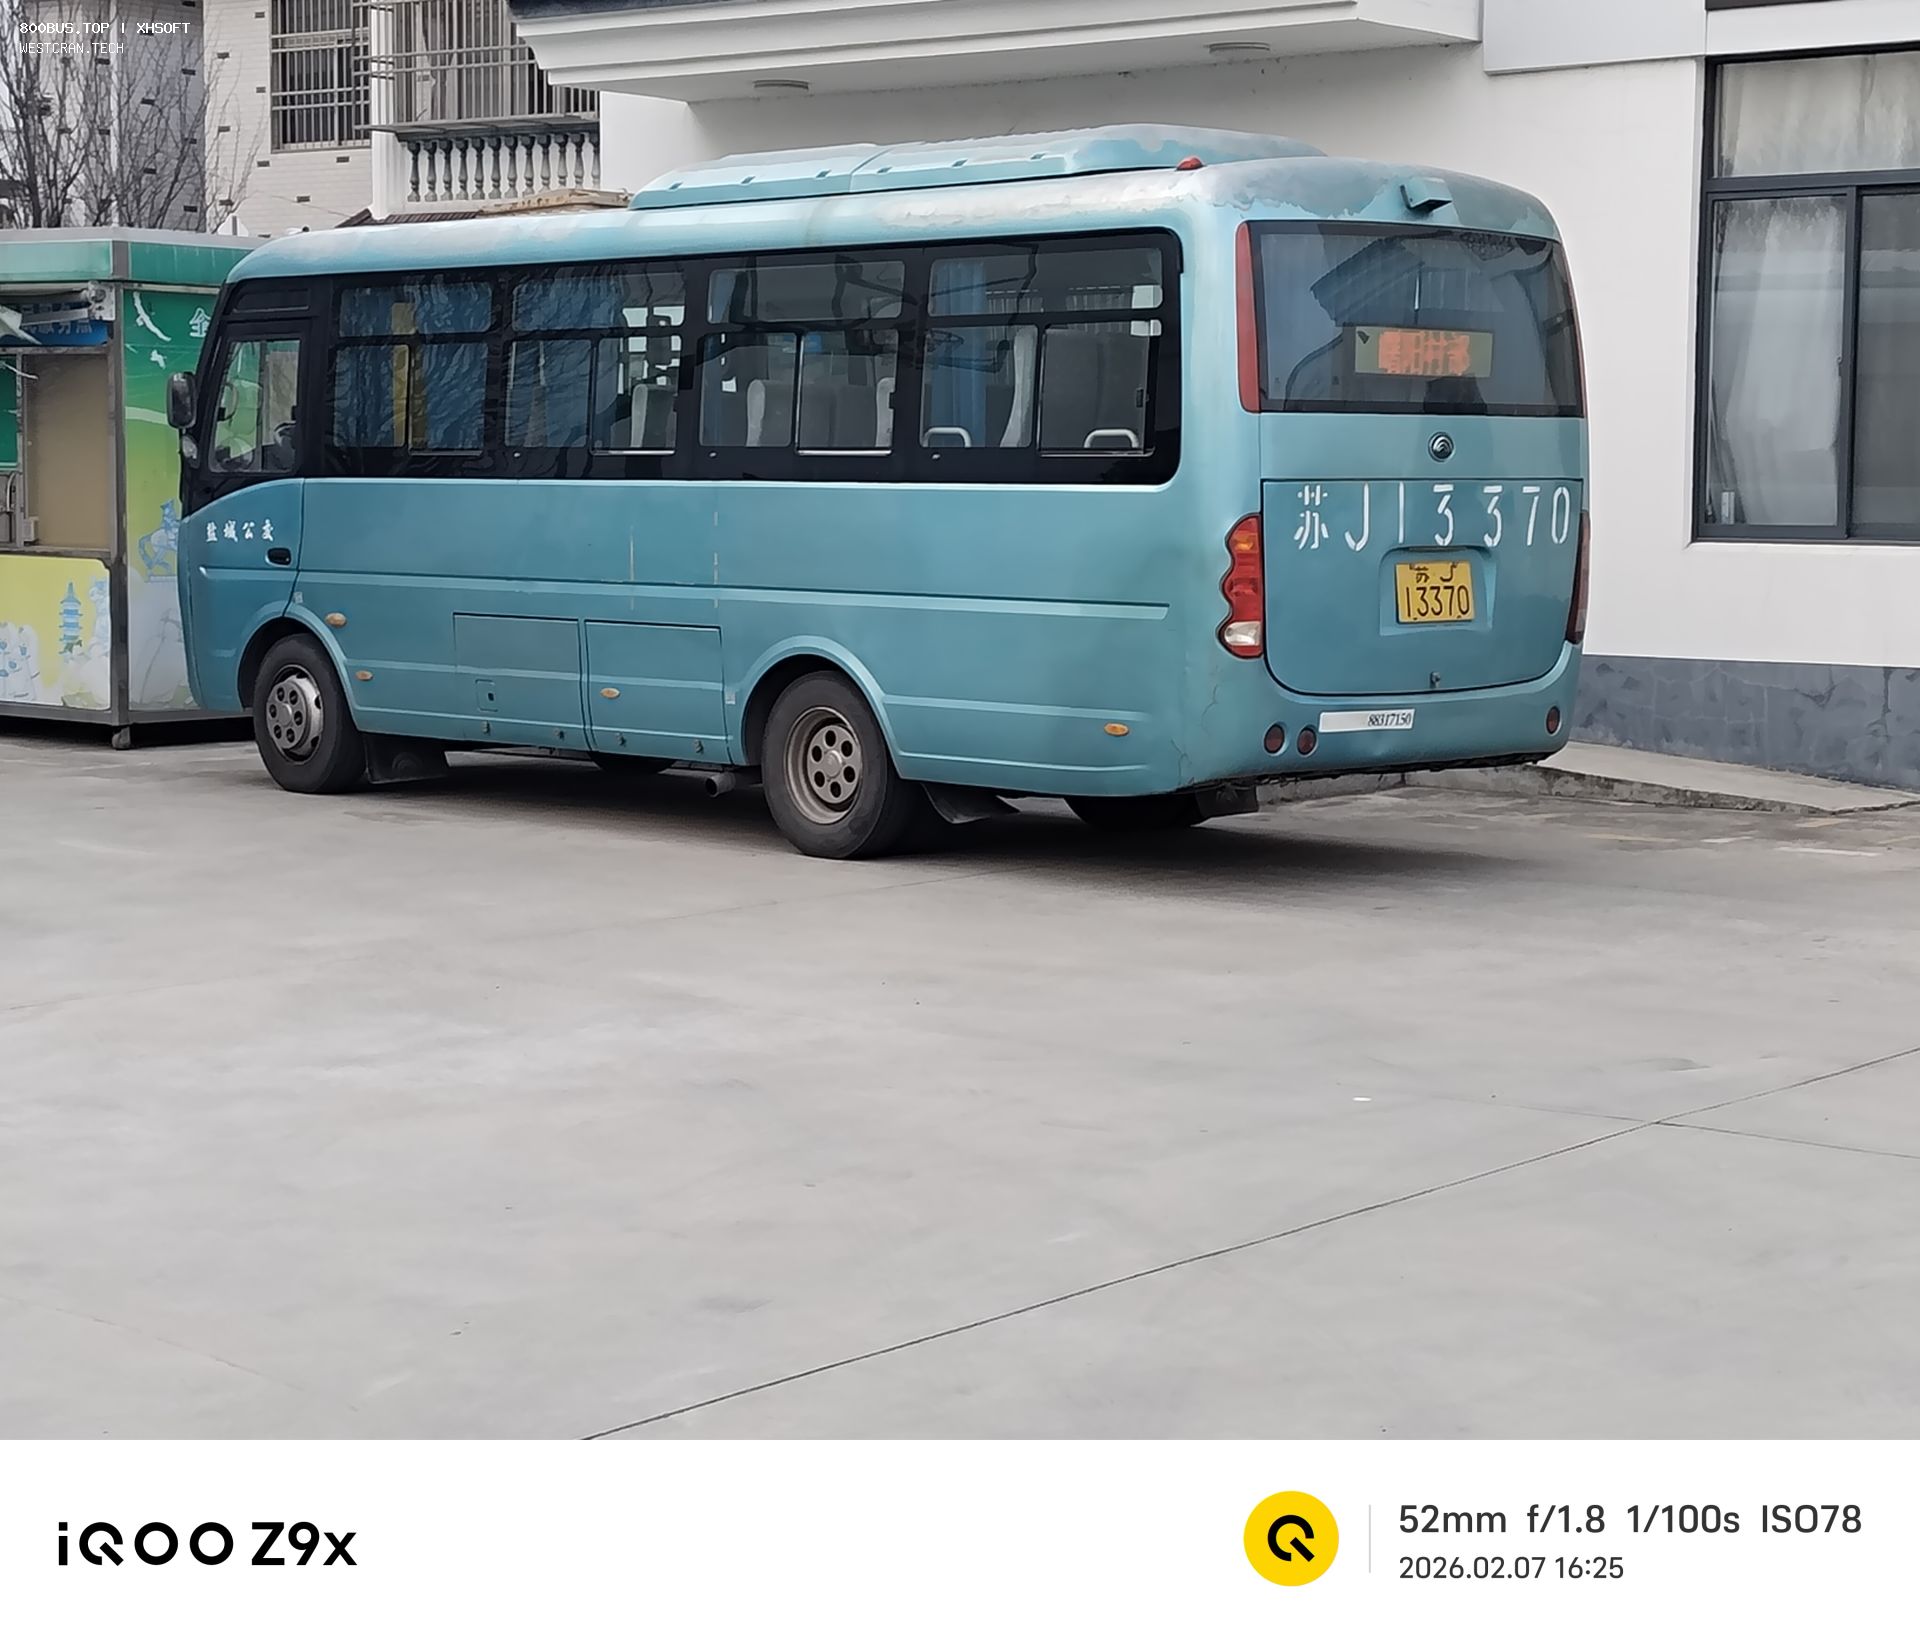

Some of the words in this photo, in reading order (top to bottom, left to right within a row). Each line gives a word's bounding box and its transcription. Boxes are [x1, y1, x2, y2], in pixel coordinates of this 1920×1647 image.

[206, 518, 274, 542] 盐城公交
[1293, 481, 1571, 552] 苏J13370
[1405, 585, 1470, 618] 13370
[1367, 713, 1412, 728] 88317150
